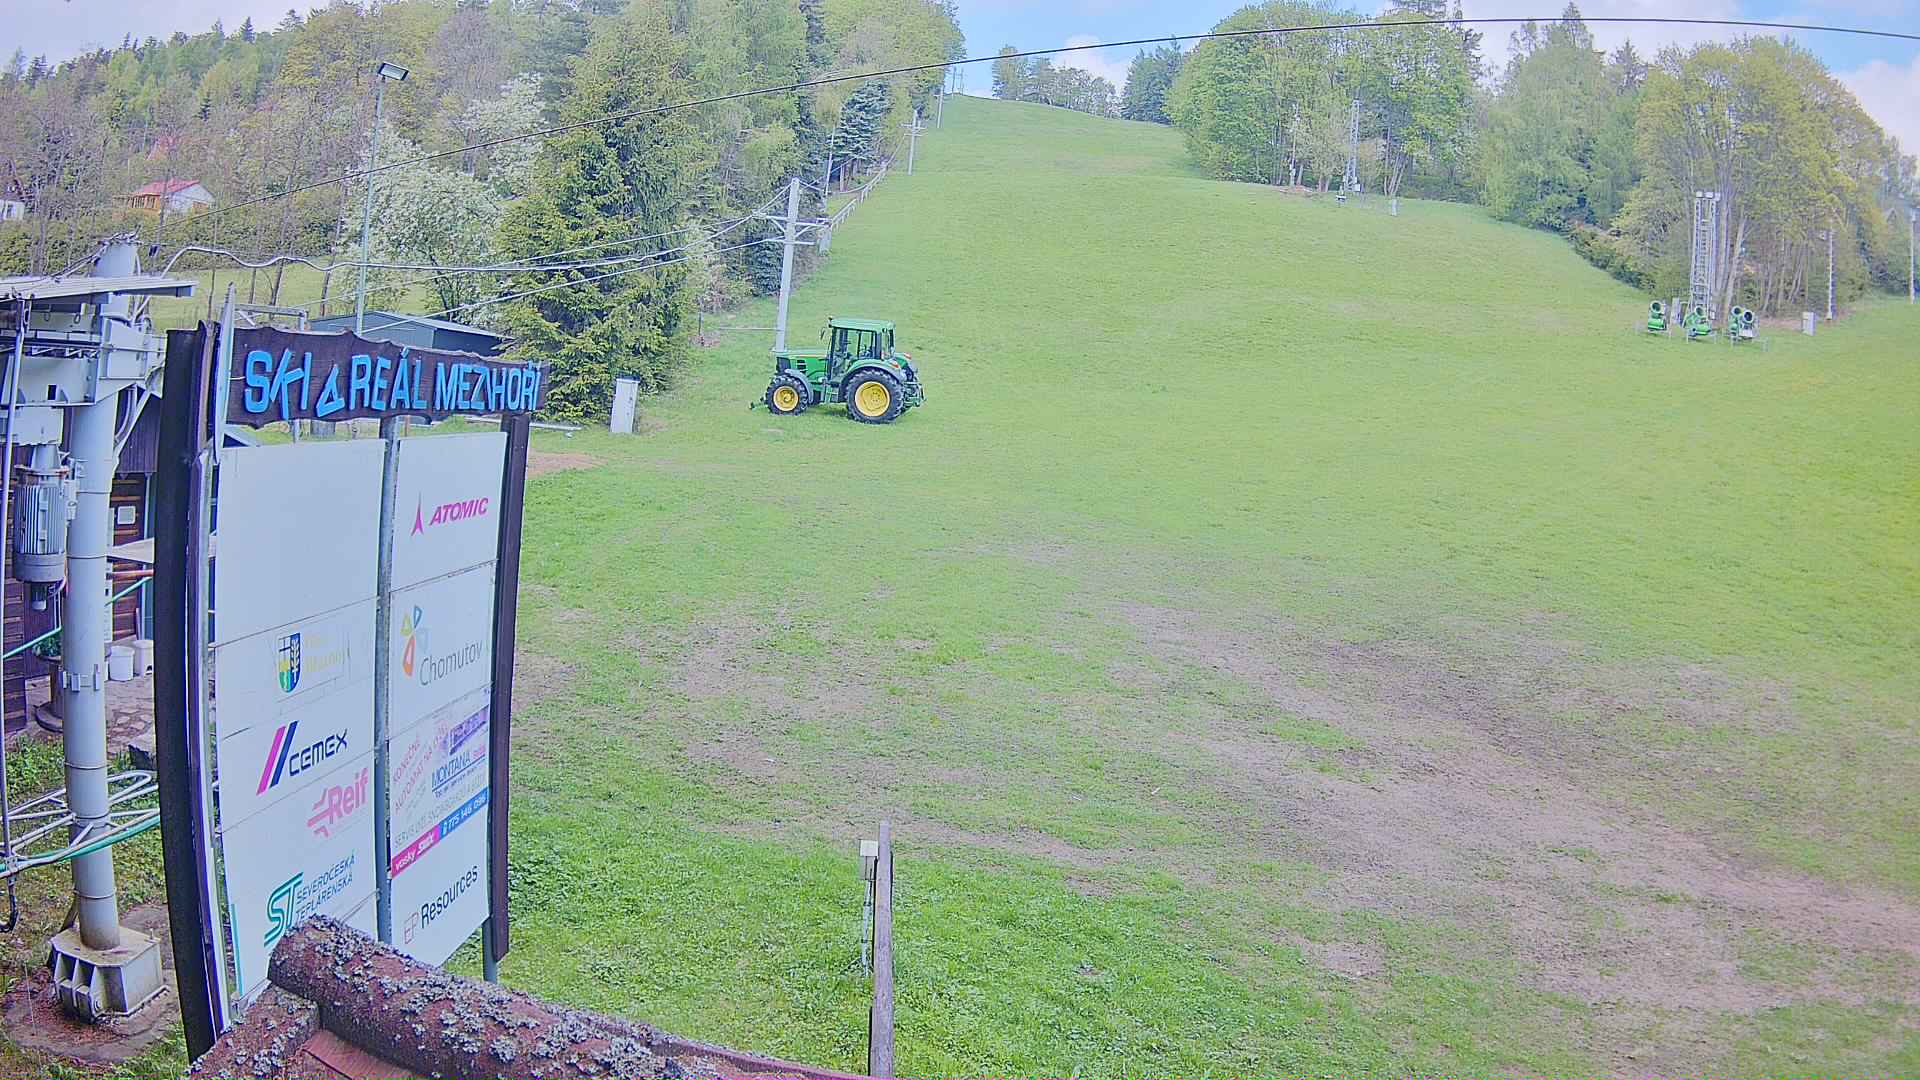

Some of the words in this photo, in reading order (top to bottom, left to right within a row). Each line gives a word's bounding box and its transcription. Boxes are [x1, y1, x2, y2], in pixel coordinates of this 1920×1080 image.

[244, 348, 313, 421] SKI
[429, 497, 489, 526] ATOMIC
[420, 639, 483, 686] Chomutov
[289, 728, 348, 777] CEMEX
[327, 767, 369, 824] Reif
[421, 865, 478, 929] Resources
